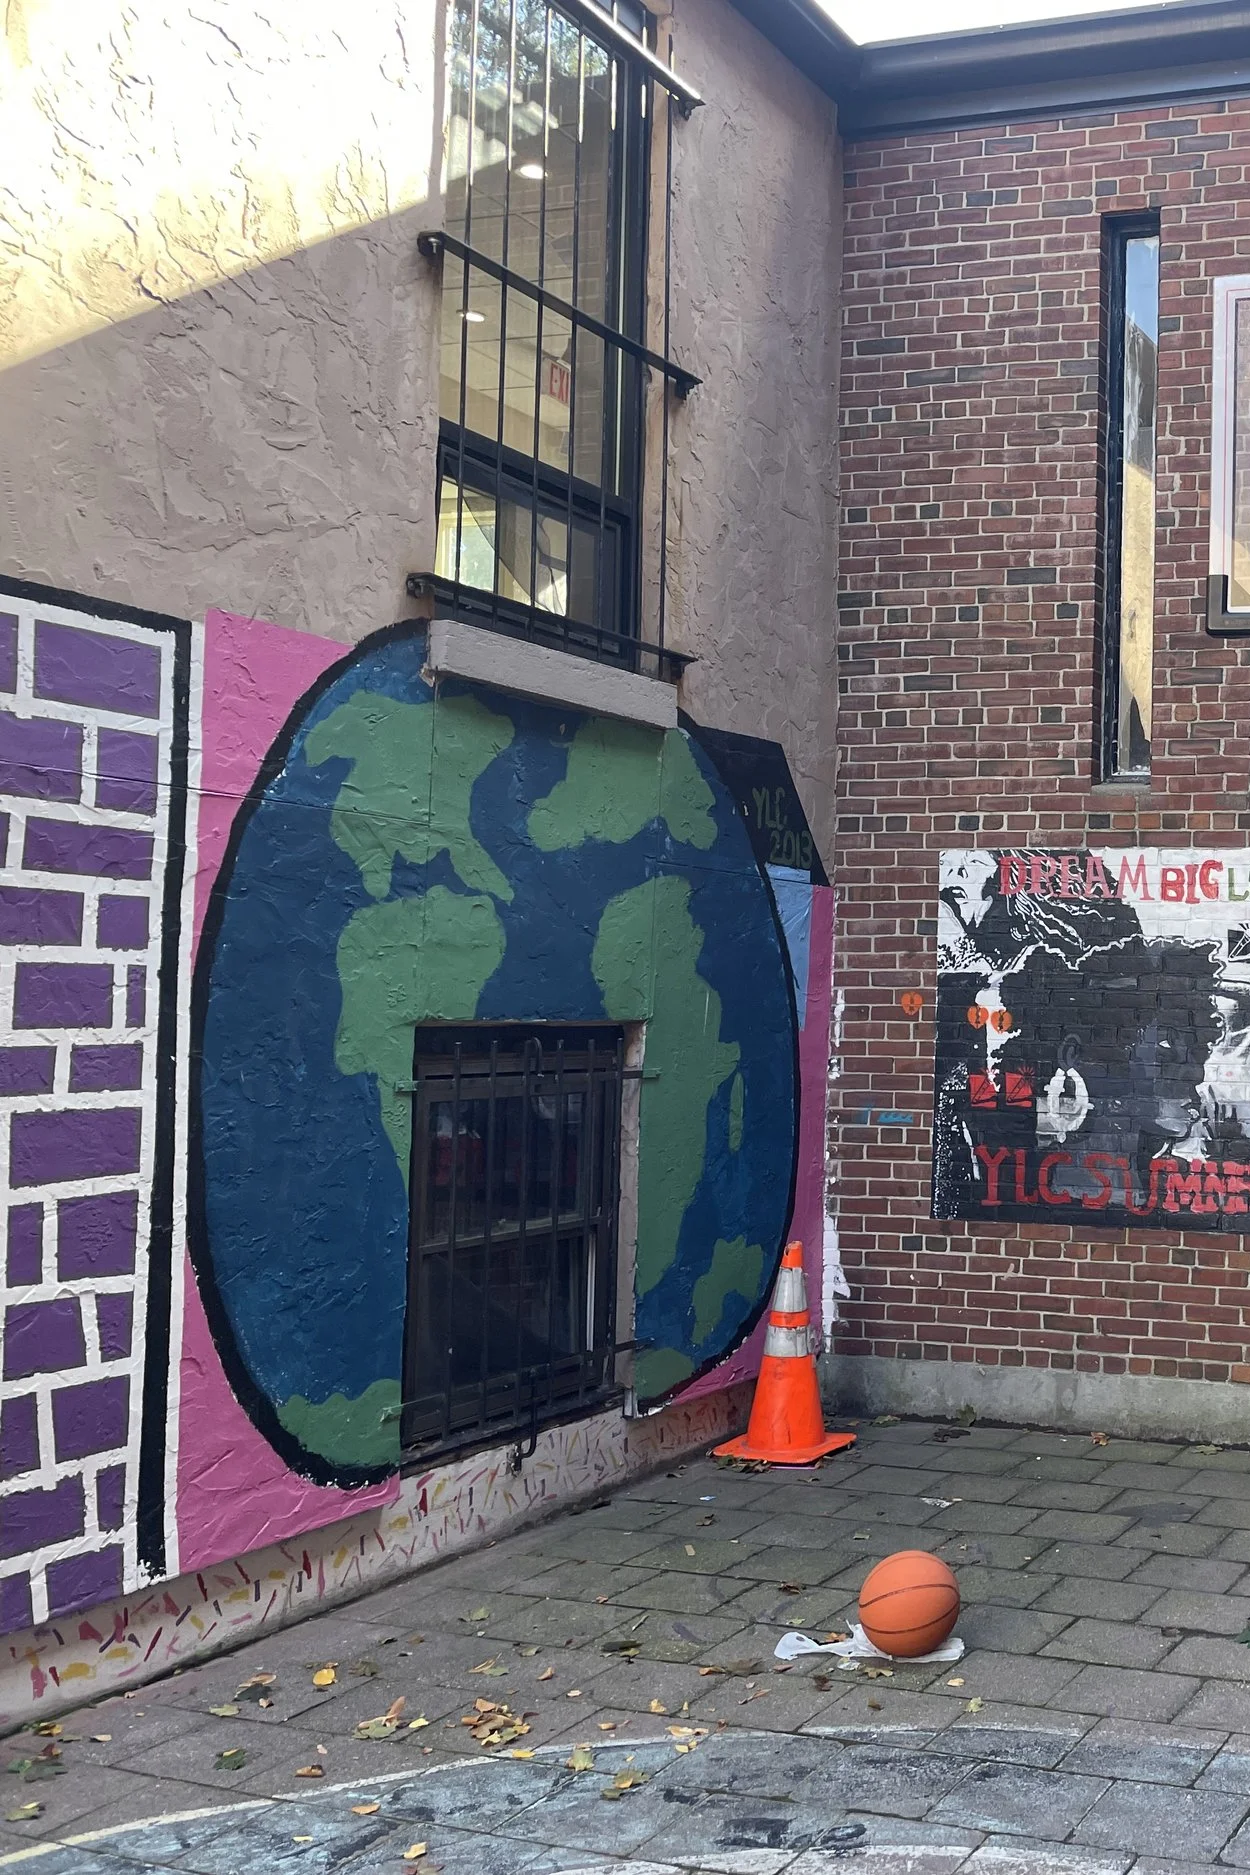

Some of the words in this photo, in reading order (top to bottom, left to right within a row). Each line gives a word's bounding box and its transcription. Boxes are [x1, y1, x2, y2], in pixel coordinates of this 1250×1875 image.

[752, 787, 787, 831] YLC
[770, 830, 814, 869] 2013
[998, 854, 1155, 901] DREAM
[1160, 859, 1223, 904] BIG
[974, 1143, 1072, 1206] YLC
